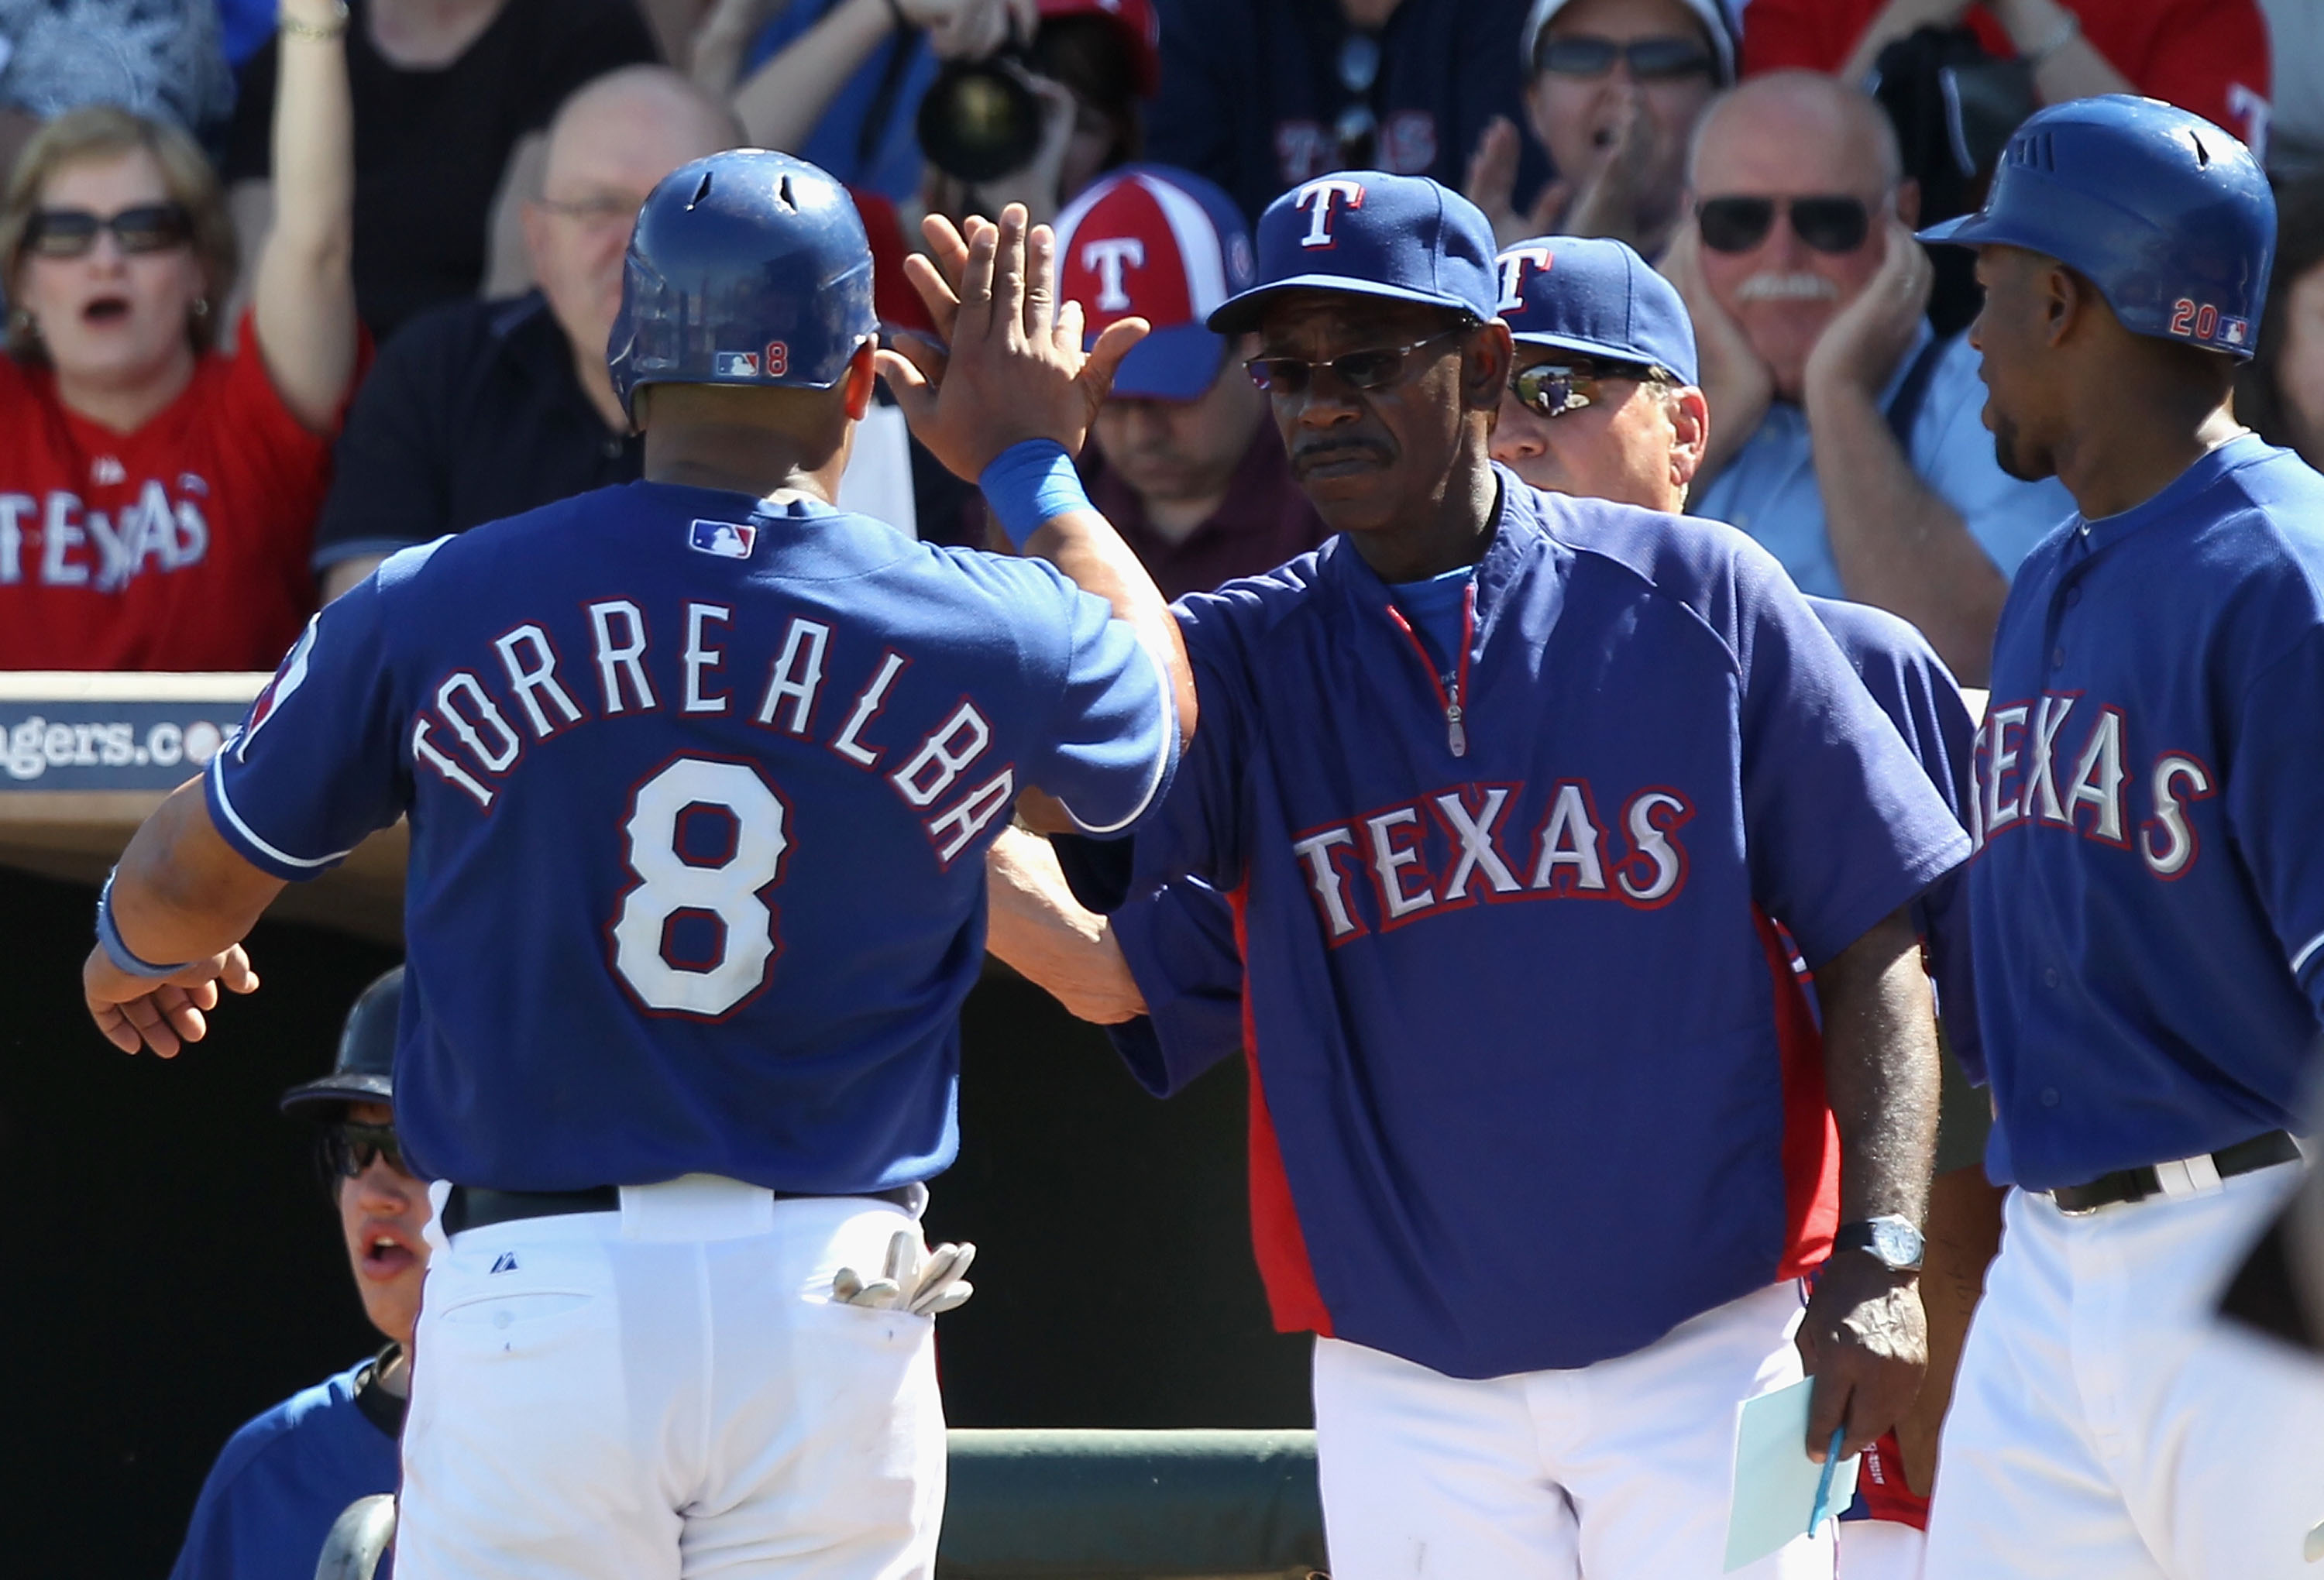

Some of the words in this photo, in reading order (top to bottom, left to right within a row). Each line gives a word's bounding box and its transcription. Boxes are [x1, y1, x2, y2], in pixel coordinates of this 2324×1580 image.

[1296, 180, 1365, 250] T
[1082, 236, 1146, 311] T
[1494, 247, 1555, 318] T
[2170, 298, 2218, 340] 20
[765, 340, 789, 377] 8
[411, 597, 1016, 867] TORREALBA
[607, 751, 794, 1022] 8
[1292, 778, 1695, 946] TEXAS
